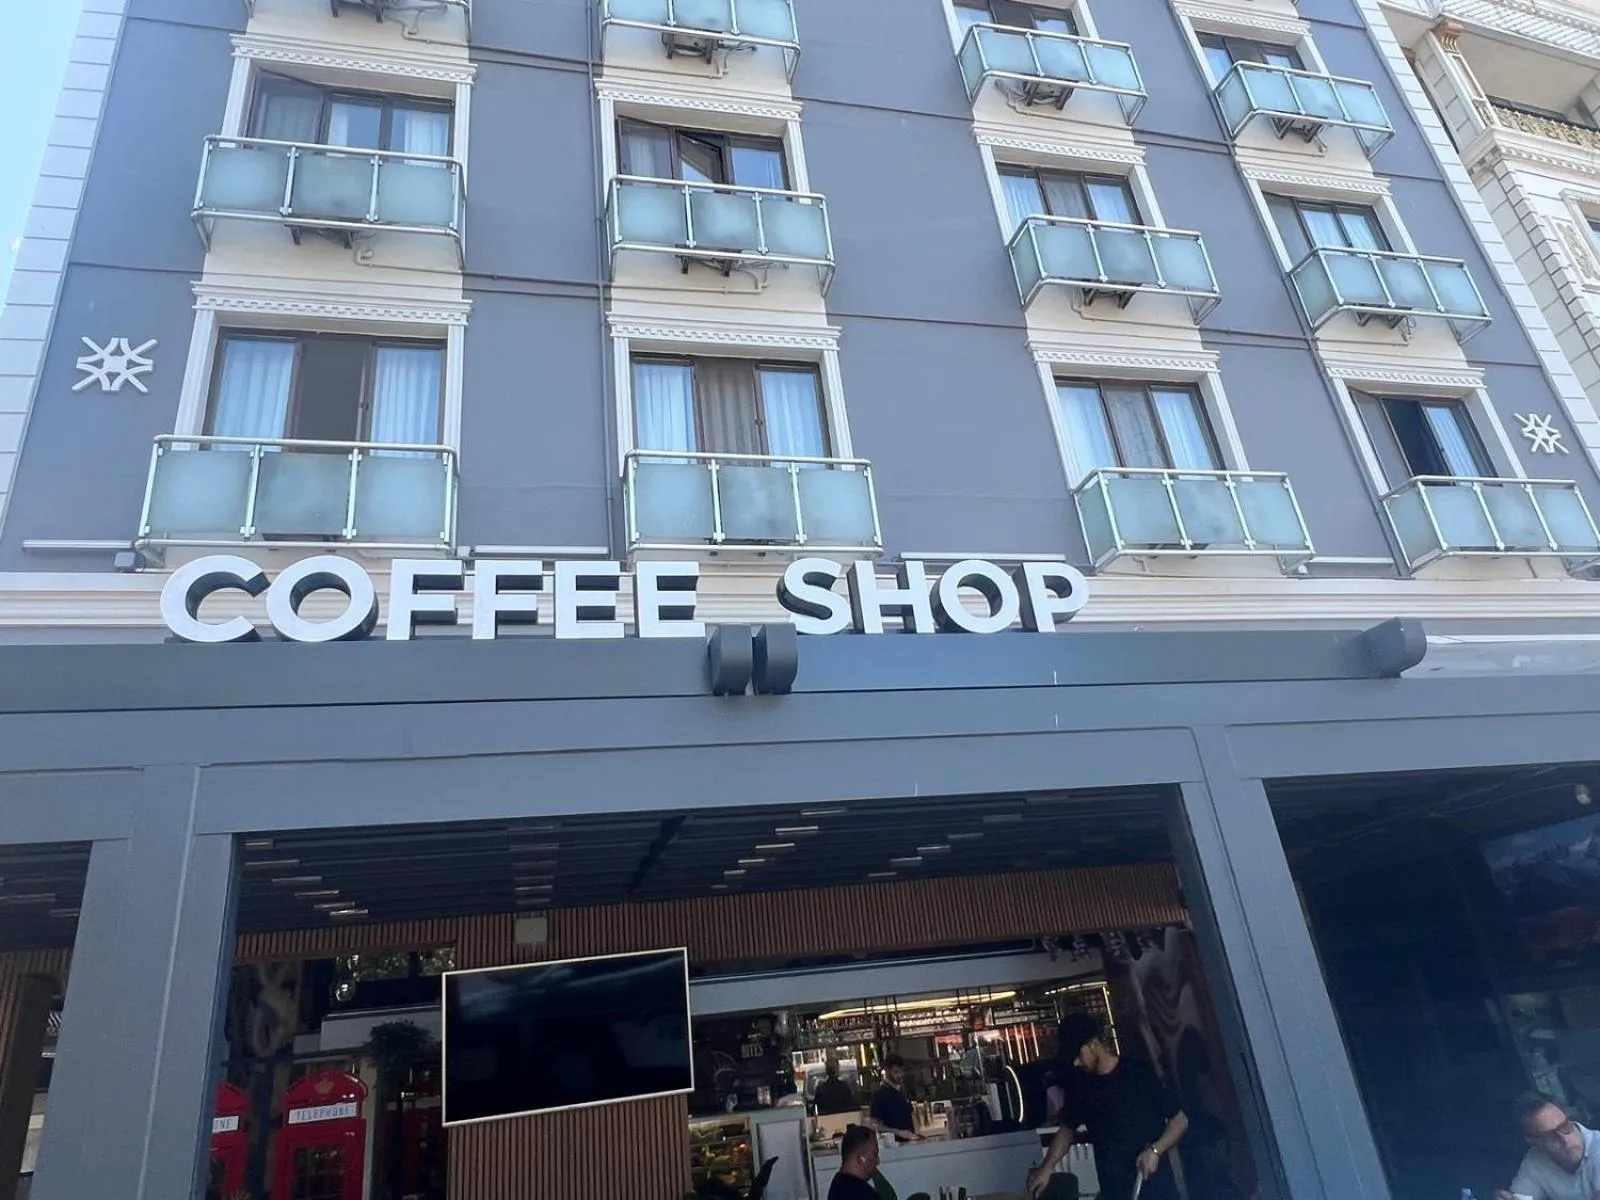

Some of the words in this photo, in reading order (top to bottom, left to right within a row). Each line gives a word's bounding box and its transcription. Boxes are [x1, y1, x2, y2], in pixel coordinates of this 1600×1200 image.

[160, 554, 705, 642] COFFEE
[777, 557, 1090, 635] SHOP
[296, 1104, 351, 1121] TELEPHONE
